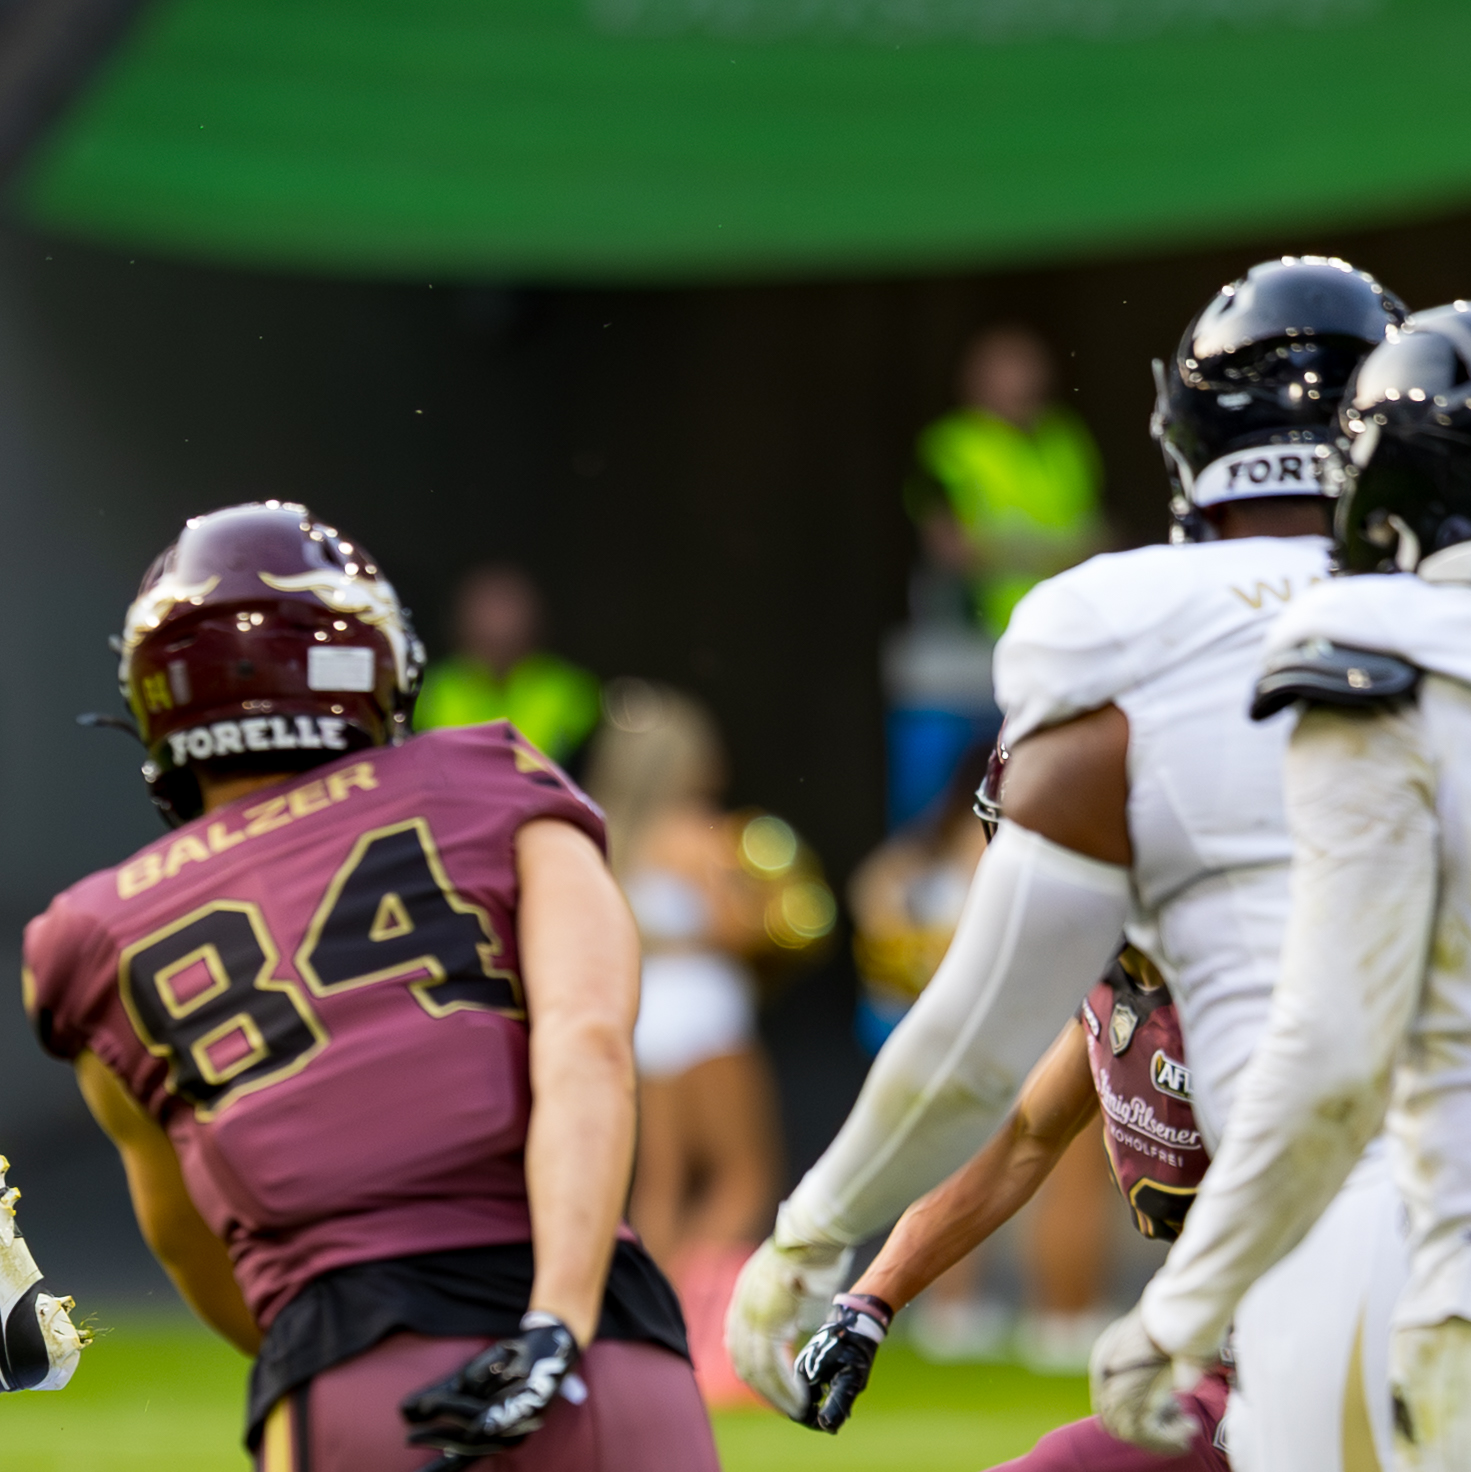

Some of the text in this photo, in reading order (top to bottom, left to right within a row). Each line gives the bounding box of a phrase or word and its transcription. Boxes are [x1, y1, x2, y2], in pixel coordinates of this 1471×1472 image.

[167, 716, 348, 766] FORELLE
[116, 761, 379, 899] BALZER
[119, 818, 530, 1123] 84
[1129, 1097, 1201, 1144] Pilsener
